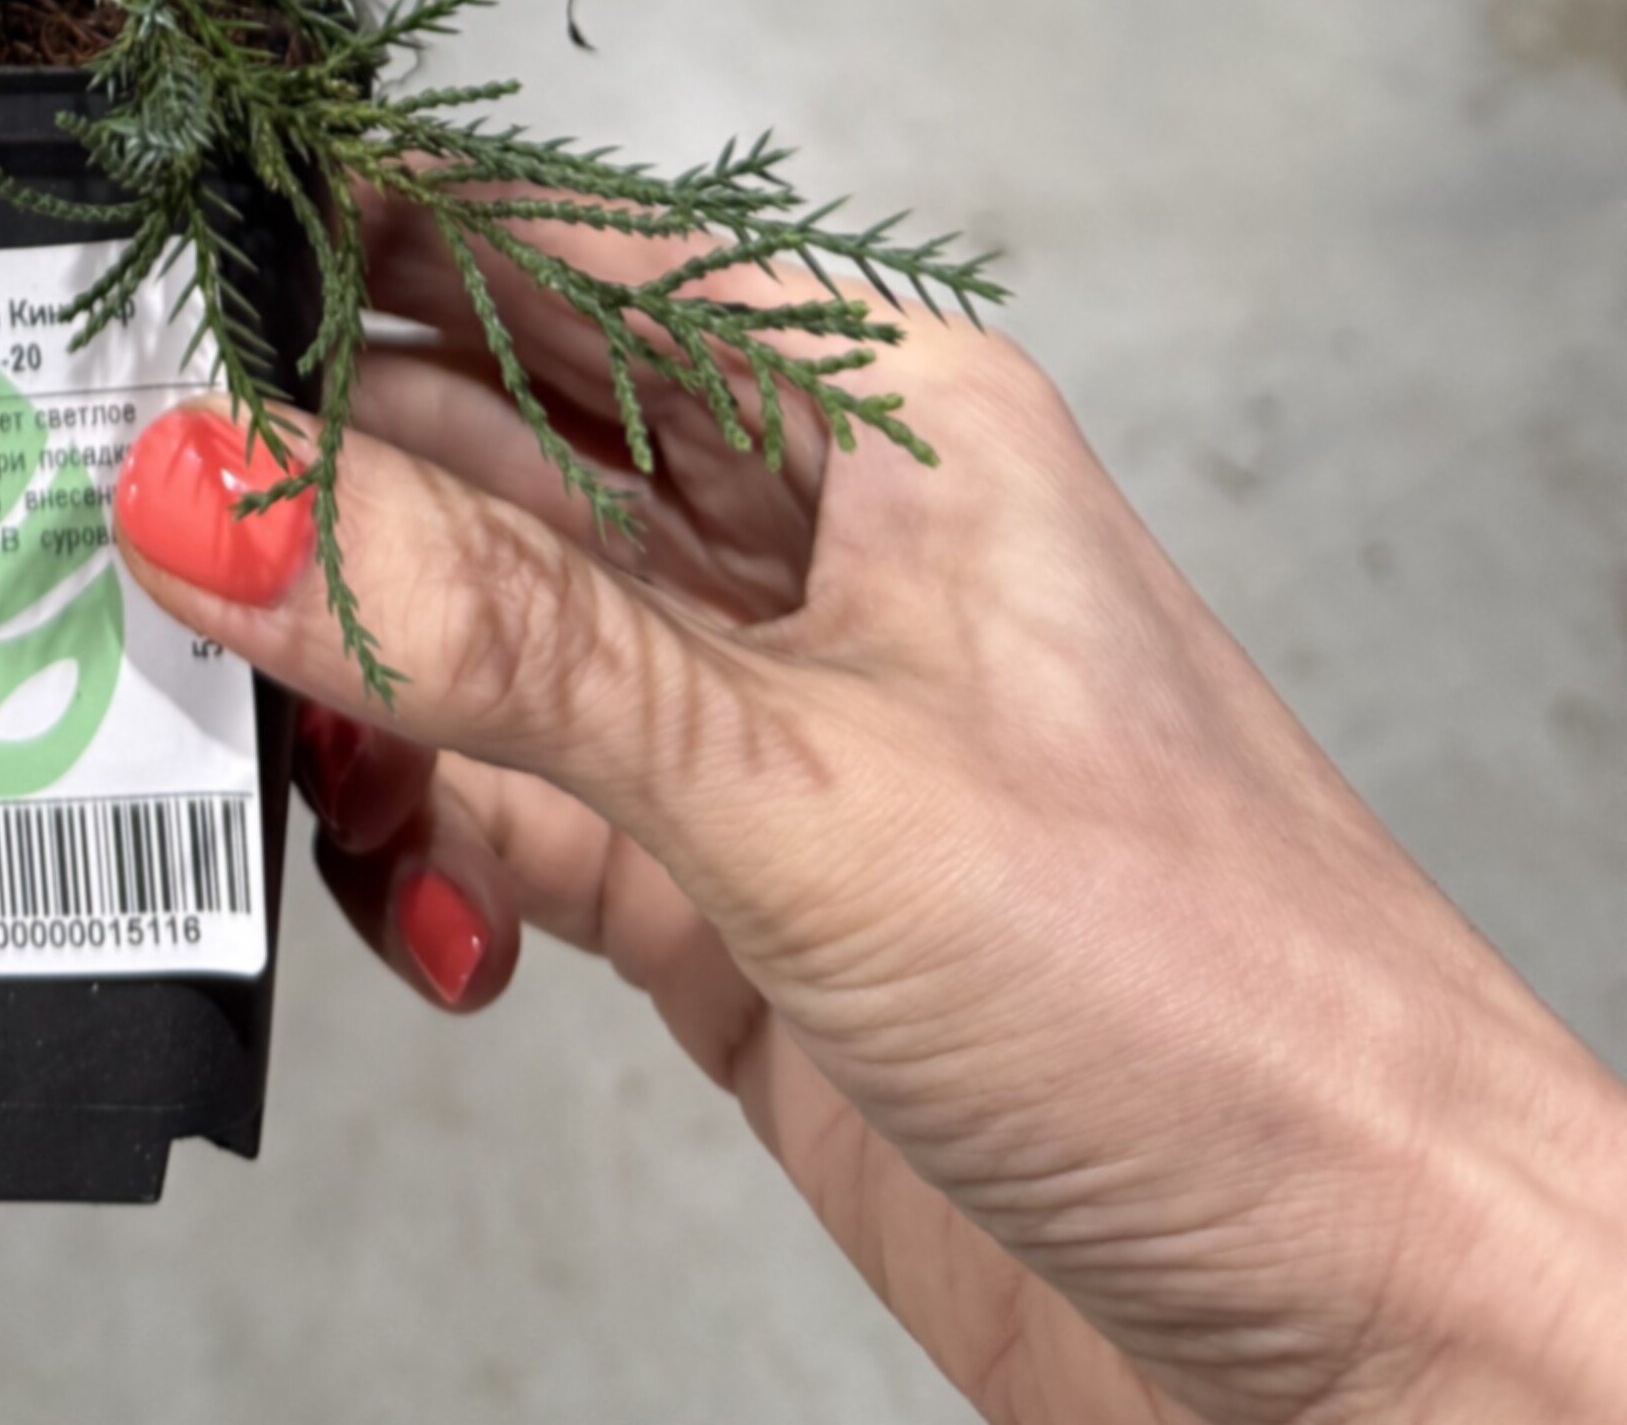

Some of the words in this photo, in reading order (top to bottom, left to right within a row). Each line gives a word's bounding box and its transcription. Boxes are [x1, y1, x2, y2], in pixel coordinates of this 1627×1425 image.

[35, 400, 137, 431] светлое
[39, 440, 132, 470] посадк
[25, 485, 122, 514] внесен
[1, 526, 22, 553] В
